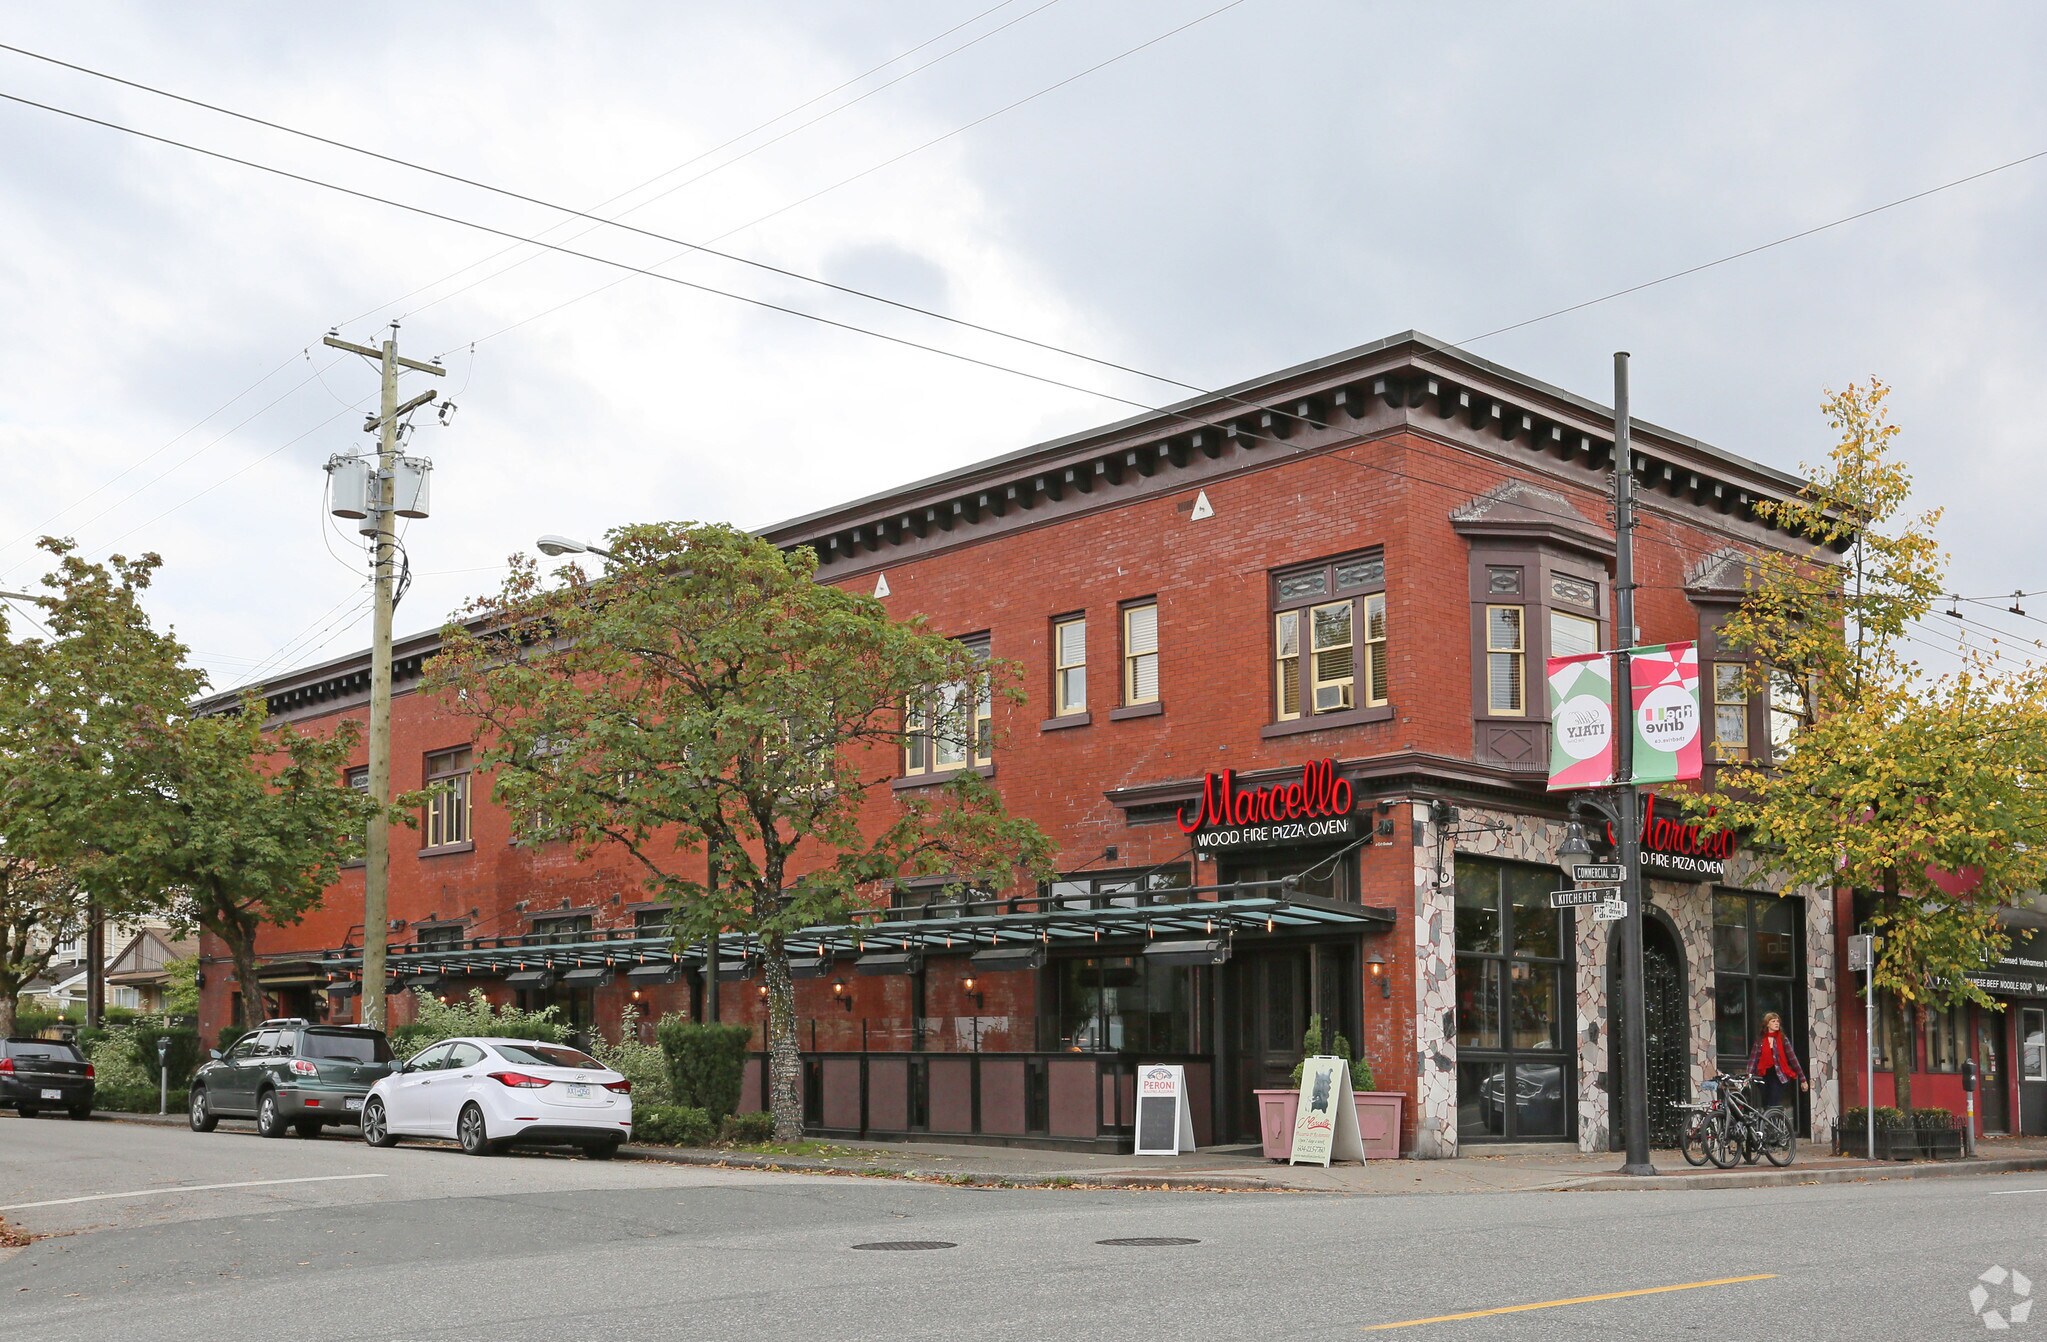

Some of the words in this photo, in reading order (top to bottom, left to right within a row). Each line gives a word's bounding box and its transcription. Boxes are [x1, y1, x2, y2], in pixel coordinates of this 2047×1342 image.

[1176, 757, 1352, 833] Marcello
[1198, 831, 1239, 847] WOOD
[1244, 827, 1268, 843] FIRE
[1272, 823, 1305, 839] PIZZA
[1308, 819, 1347, 837] OVEN
[1651, 852, 1669, 868] FIRE
[1672, 856, 1696, 870] PIZZA
[1697, 860, 1724, 874] OVEN
[1577, 867, 1609, 878] COMMERCIAL
[1558, 892, 1597, 904] KITCHENER
[1998, 957, 2018, 965] icensed
[2019, 957, 2044, 967] Vietnamese
[1987, 979, 1999, 988] BEEF
[2000, 980, 2019, 990] NOODLE
[2020, 982, 2032, 991] SOUP
[1144, 1081, 1175, 1089] PERONI
